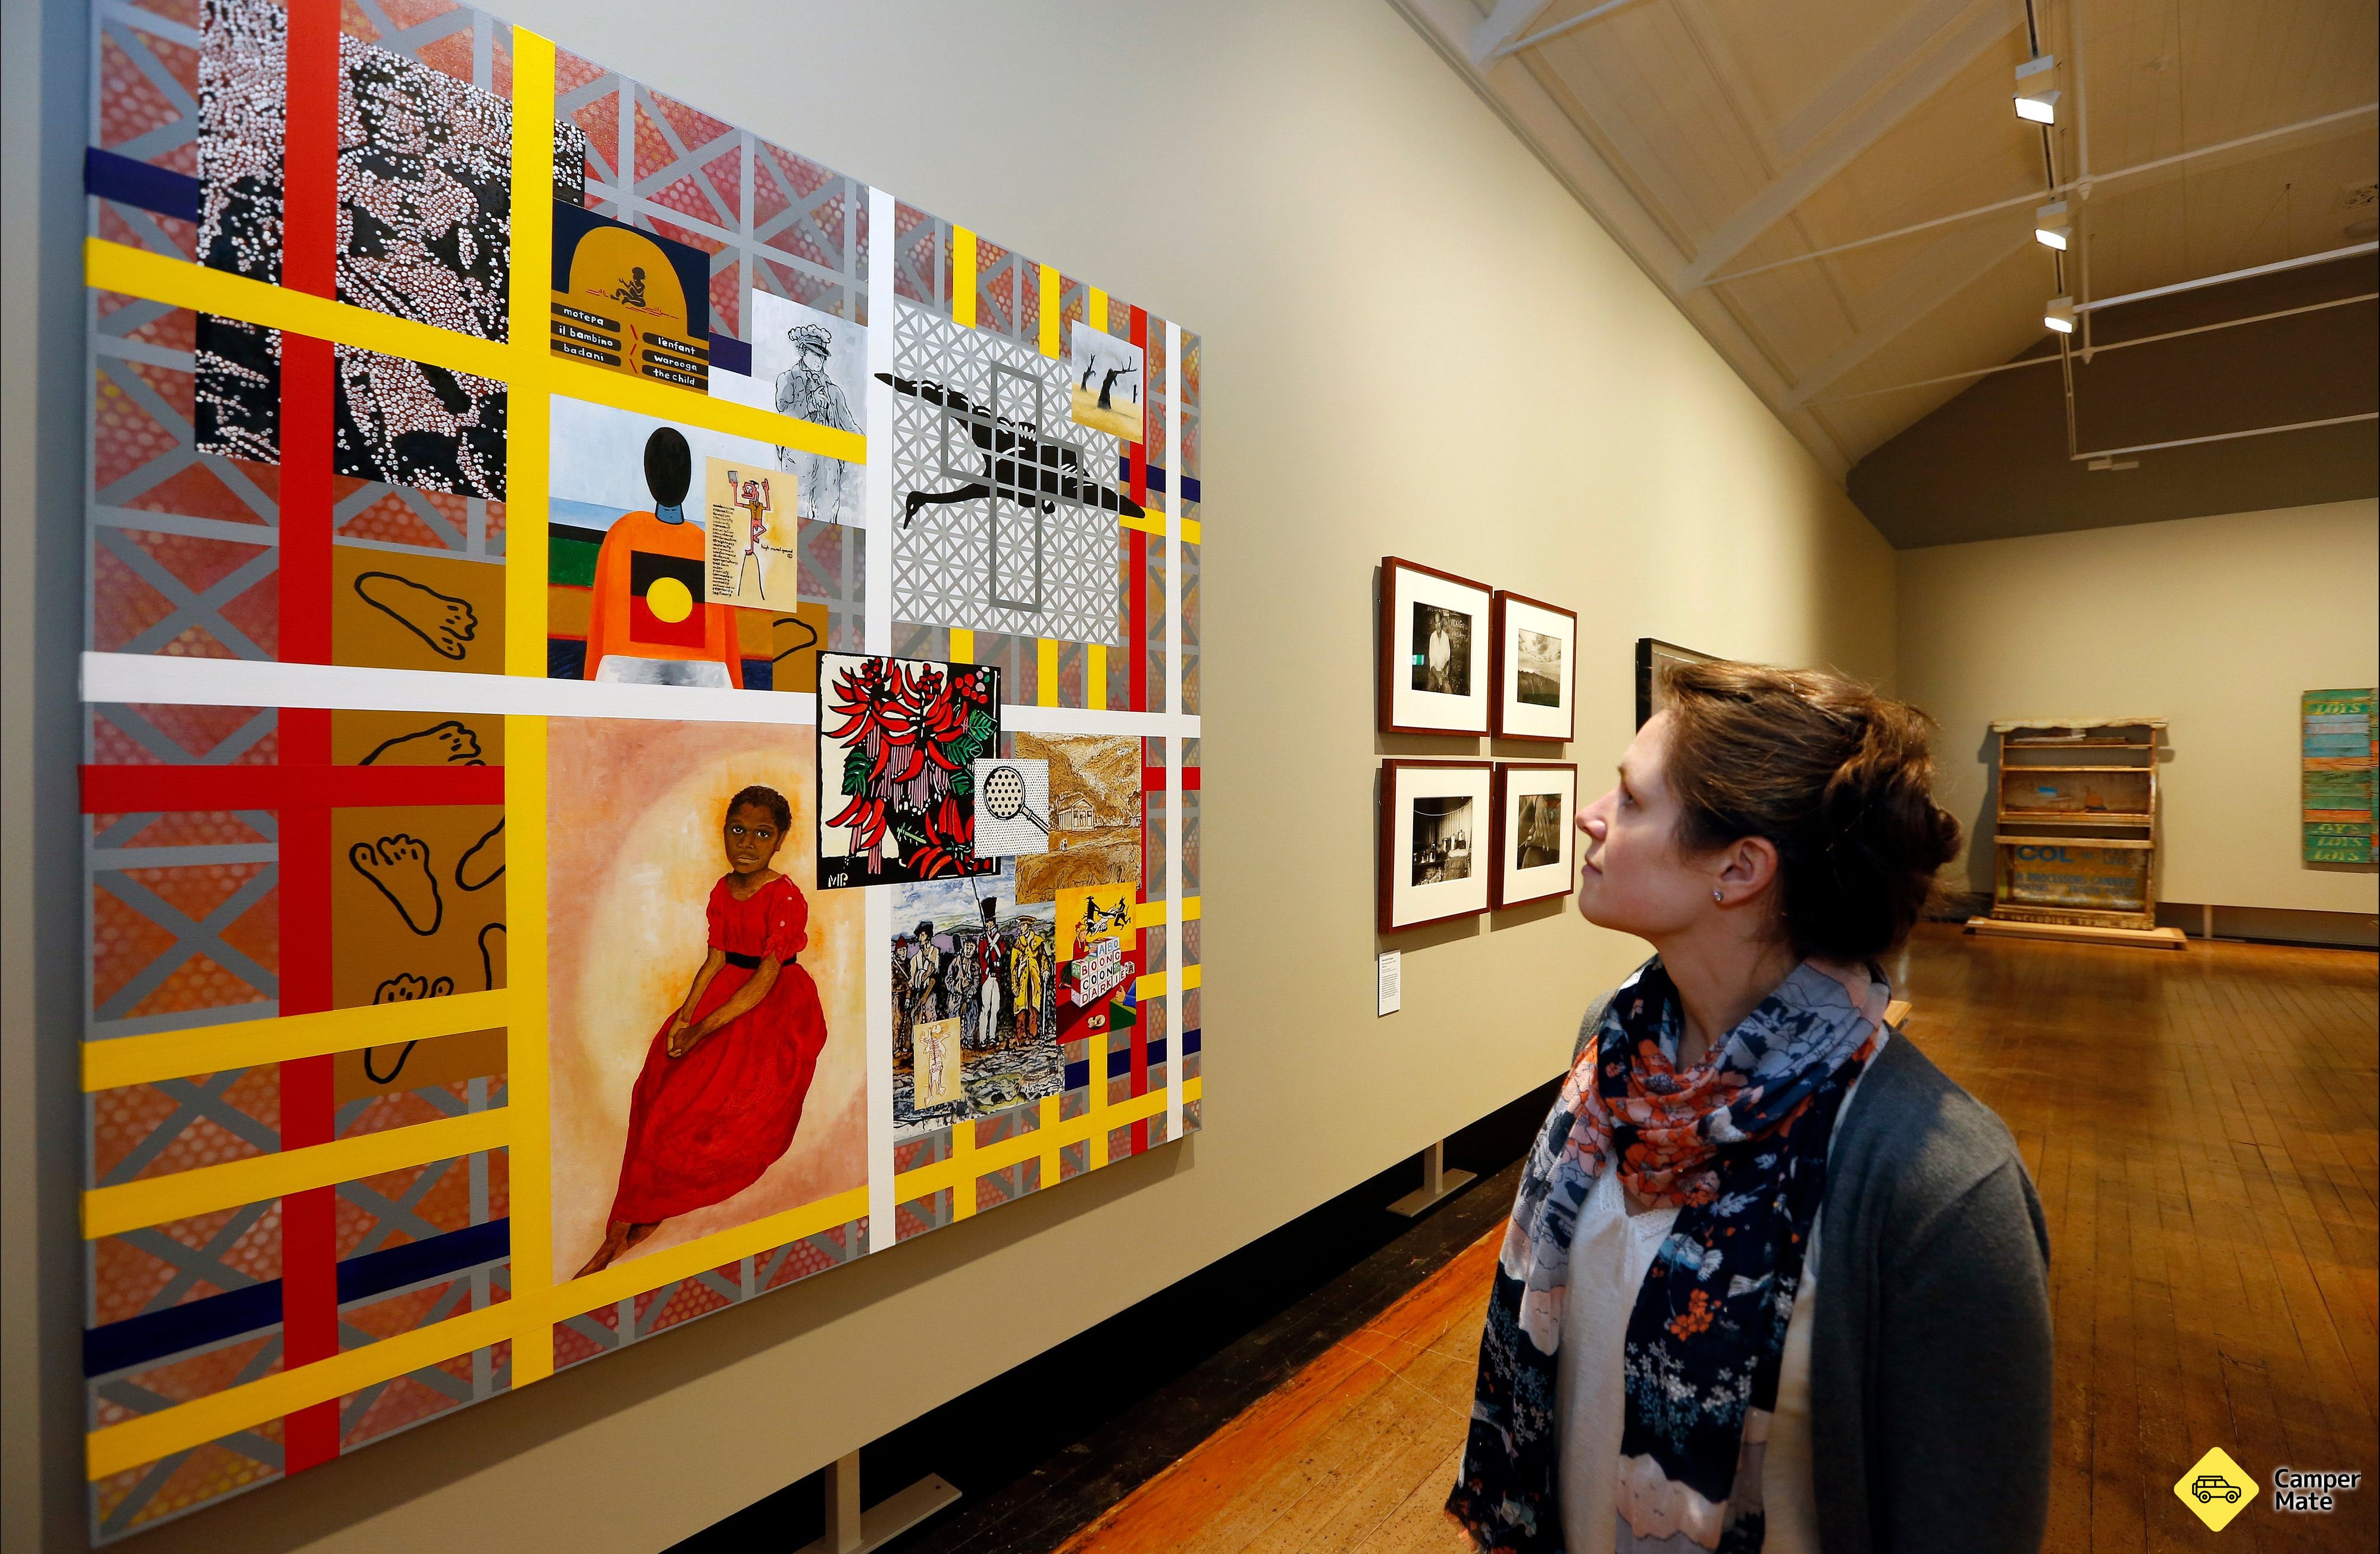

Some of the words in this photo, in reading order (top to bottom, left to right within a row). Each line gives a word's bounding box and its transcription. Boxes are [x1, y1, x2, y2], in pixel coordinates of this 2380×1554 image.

[563, 308, 604, 326] motepa
[559, 325, 566, 336] il
[569, 327, 613, 347] bambino
[563, 343, 604, 362] badani
[654, 354, 698, 371] warooga
[653, 367, 670, 380] the
[672, 373, 695, 386] child
[2018, 846, 2074, 863] COL
[1099, 939, 1119, 955] ABO
[1082, 952, 1120, 976] BOONG
[1082, 966, 1113, 990] COON
[1082, 970, 1125, 1003] DARKIE
